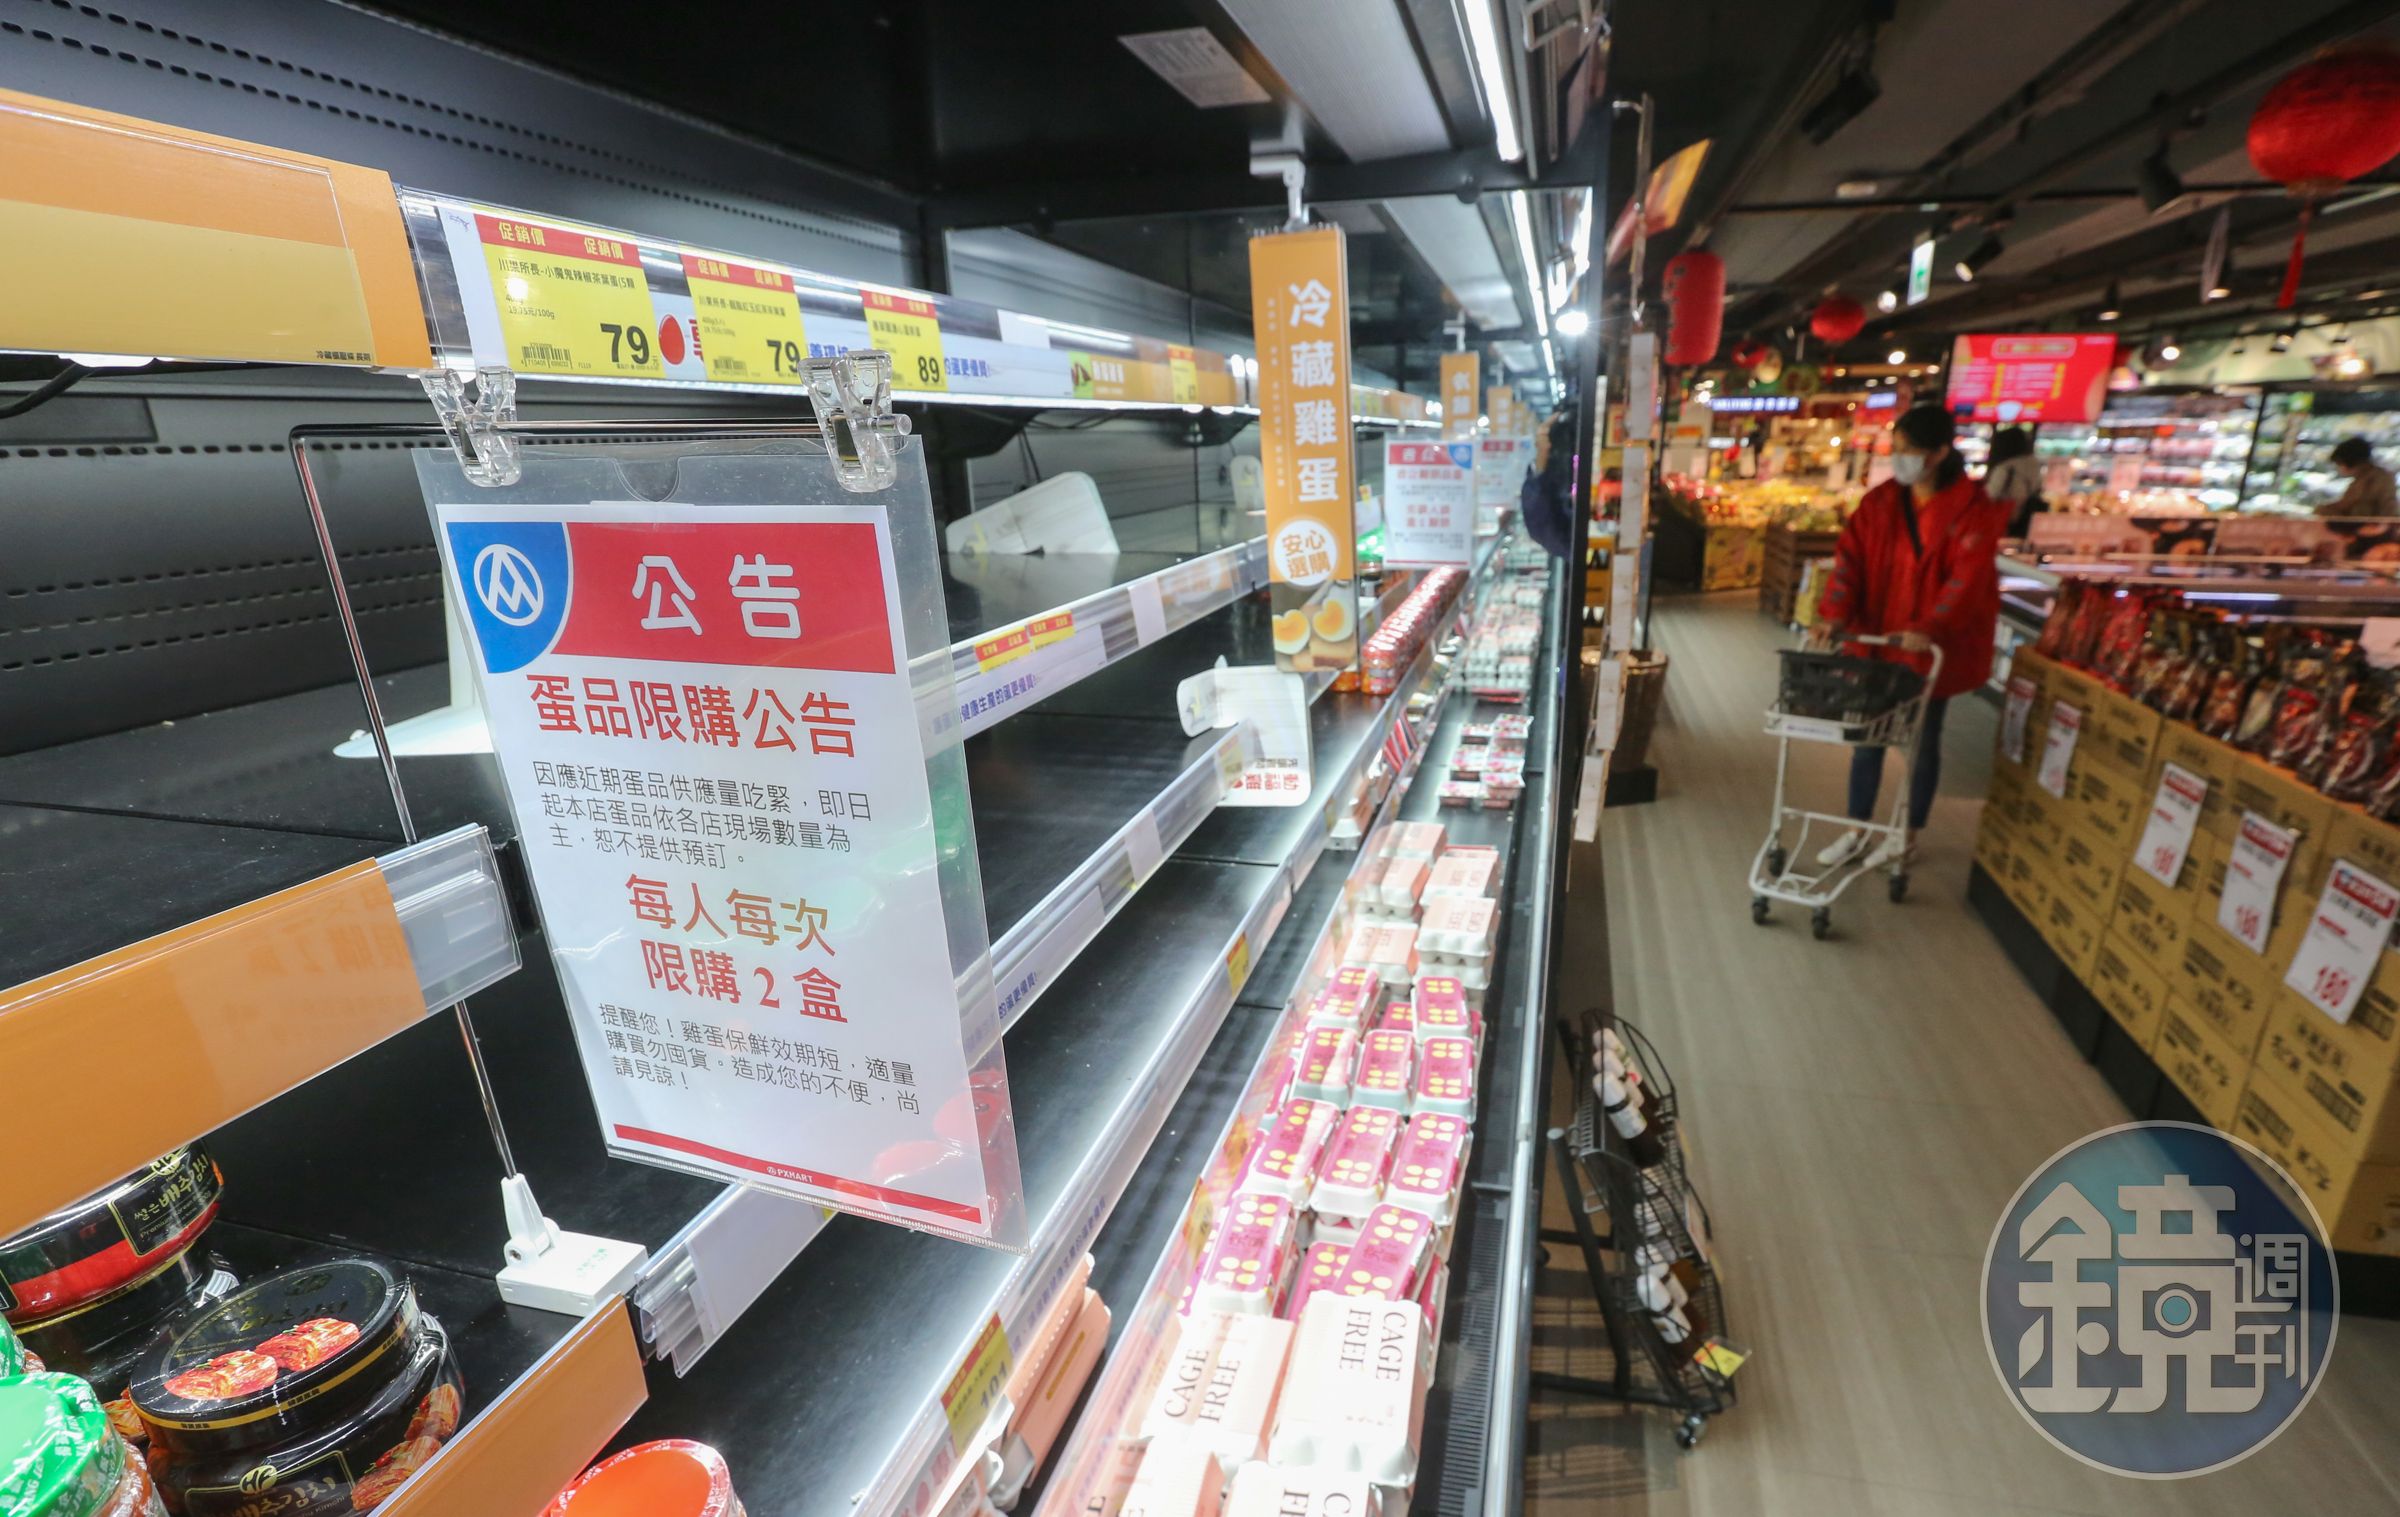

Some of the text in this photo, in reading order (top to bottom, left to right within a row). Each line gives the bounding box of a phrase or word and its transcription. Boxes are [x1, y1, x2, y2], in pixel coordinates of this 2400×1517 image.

[498, 221, 625, 260] 促銷價 促銷價
[600, 323, 650, 365] 79
[766, 339, 800, 373] 79
[918, 355, 940, 383] 89
[1287, 278, 1339, 503] 冷藏雞蛋
[1282, 529, 1326, 558] 安心
[631, 553, 802, 639] 公告
[526, 674, 857, 758] 蛋品限購公告
[532, 760, 873, 822] 因應近期蛋品供應量吃緊，即日
[540, 792, 851, 854] 起本店蛋品依各店現場數量為
[624, 873, 836, 957] 每人每次
[598, 1003, 917, 1087] 提醒您！雞蛋保鮮效期短，適量
[614, 1056, 690, 1091] 請見諒！
[777, 1168, 813, 1184] PXMART
[1339, 1308, 1372, 1372] FREE
[1374, 1311, 1408, 1382] CAGE
[1164, 1348, 1209, 1418] CAGE
[1198, 1358, 1241, 1423] FREE
